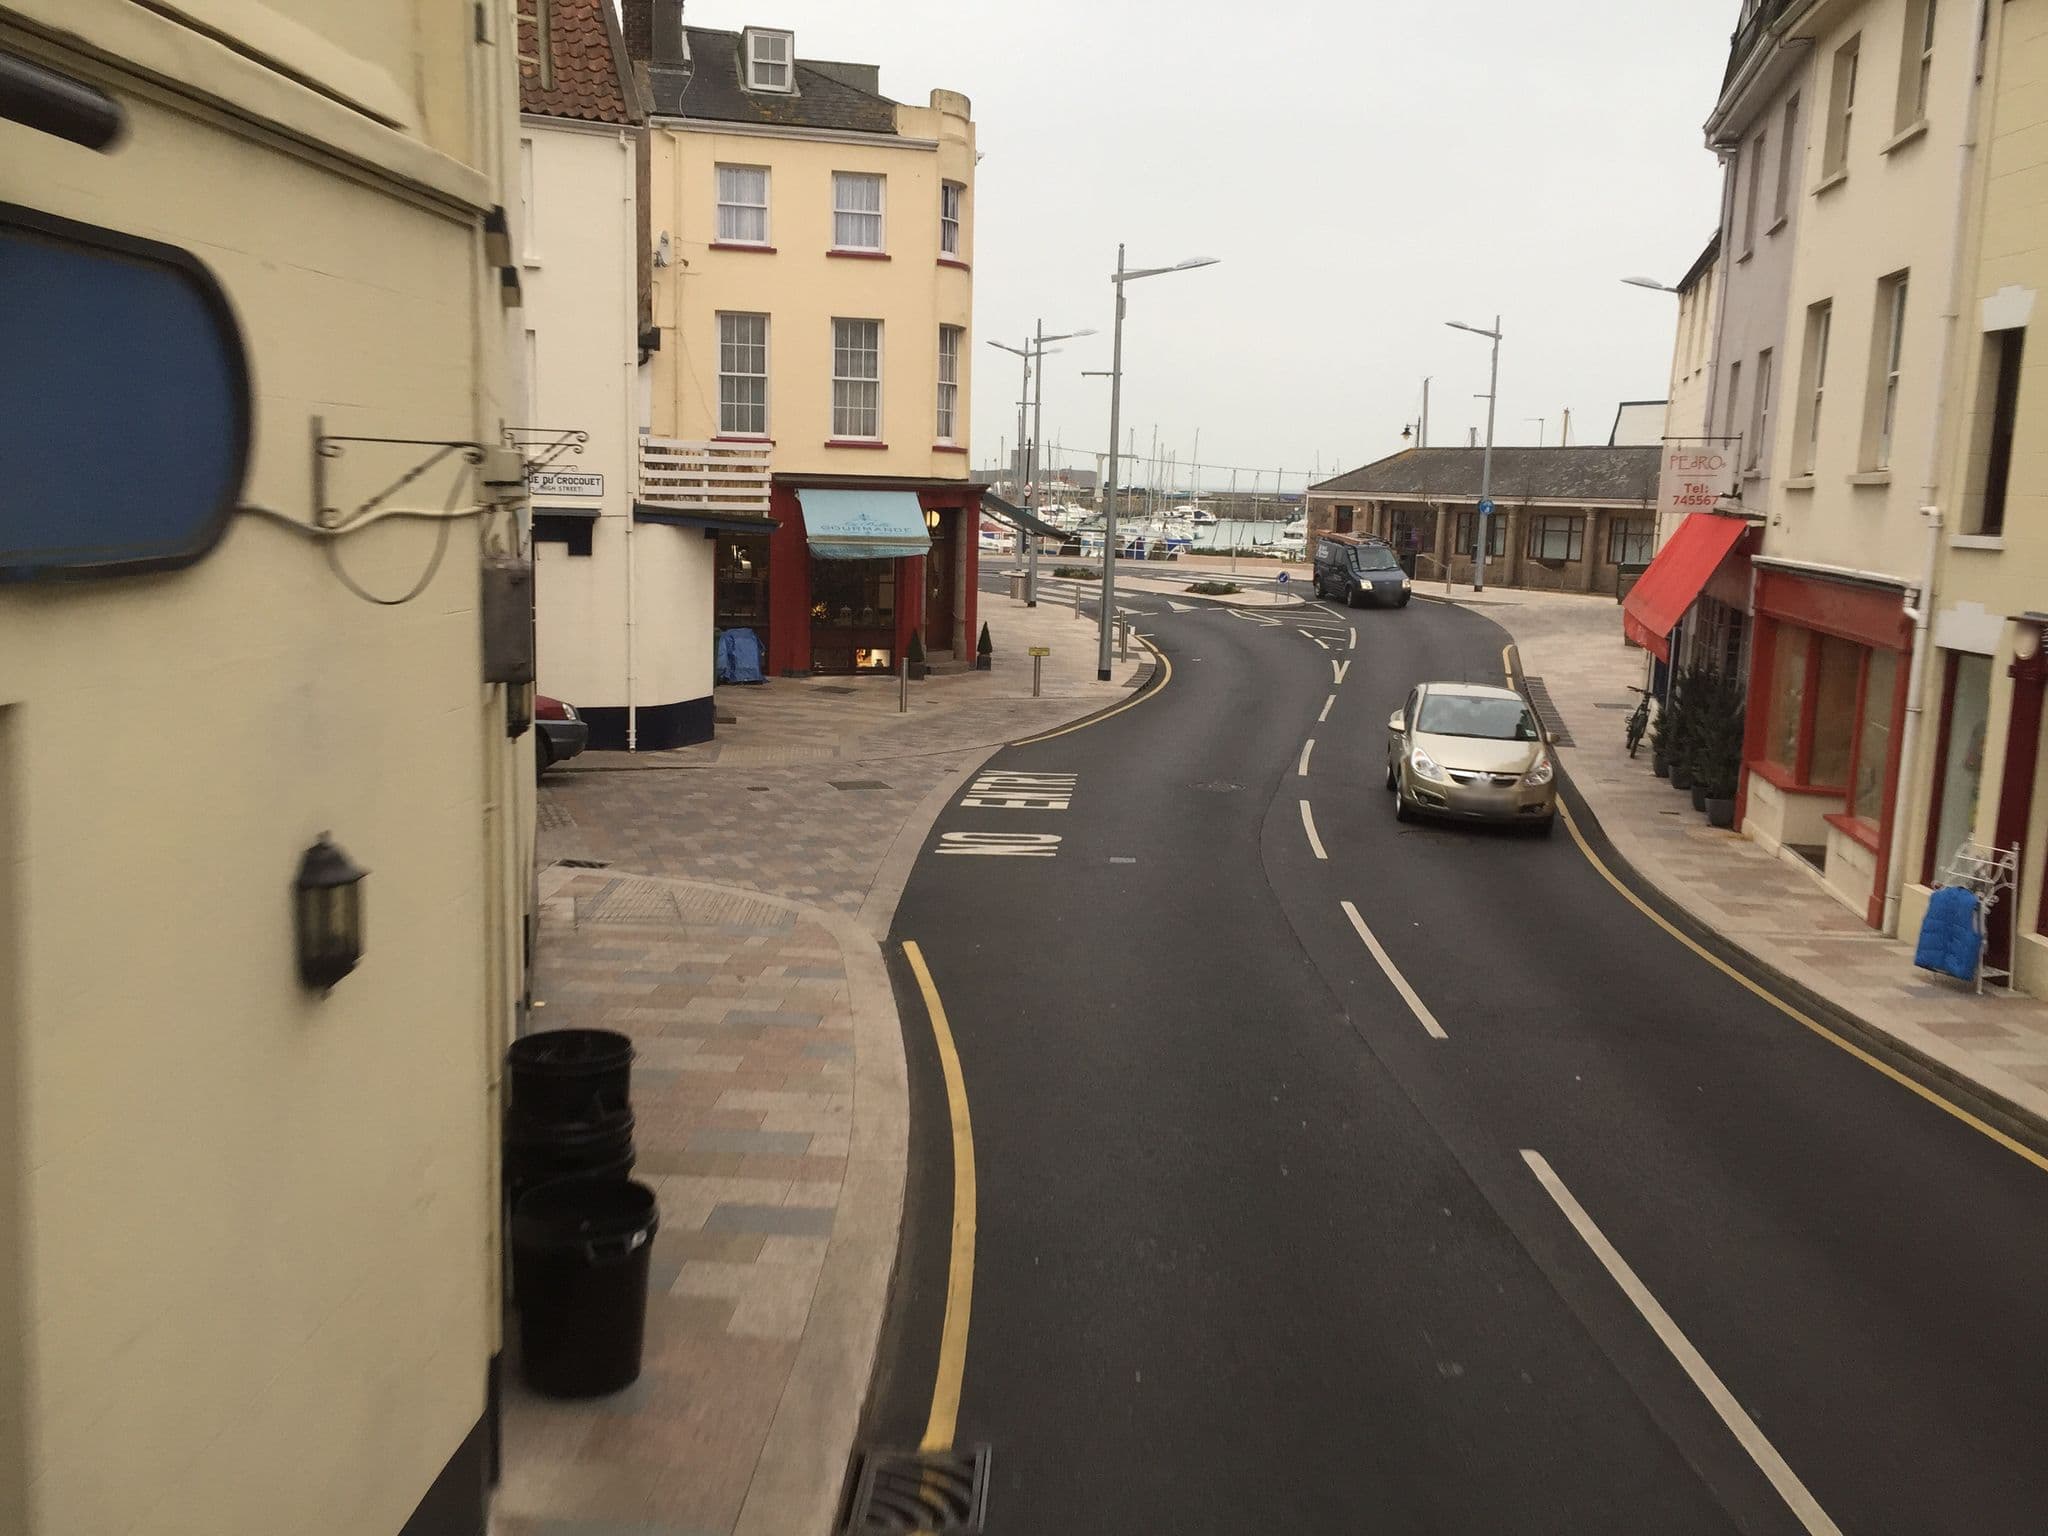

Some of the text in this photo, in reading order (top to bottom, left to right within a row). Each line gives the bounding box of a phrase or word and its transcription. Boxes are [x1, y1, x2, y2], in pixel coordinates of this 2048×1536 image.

[543, 476, 553, 485] DU
[556, 477, 600, 486] CROCQUET
[1684, 483, 1709, 494] Tel:
[1673, 495, 1719, 506] 745567
[935, 770, 1079, 857] NO ENTRY
